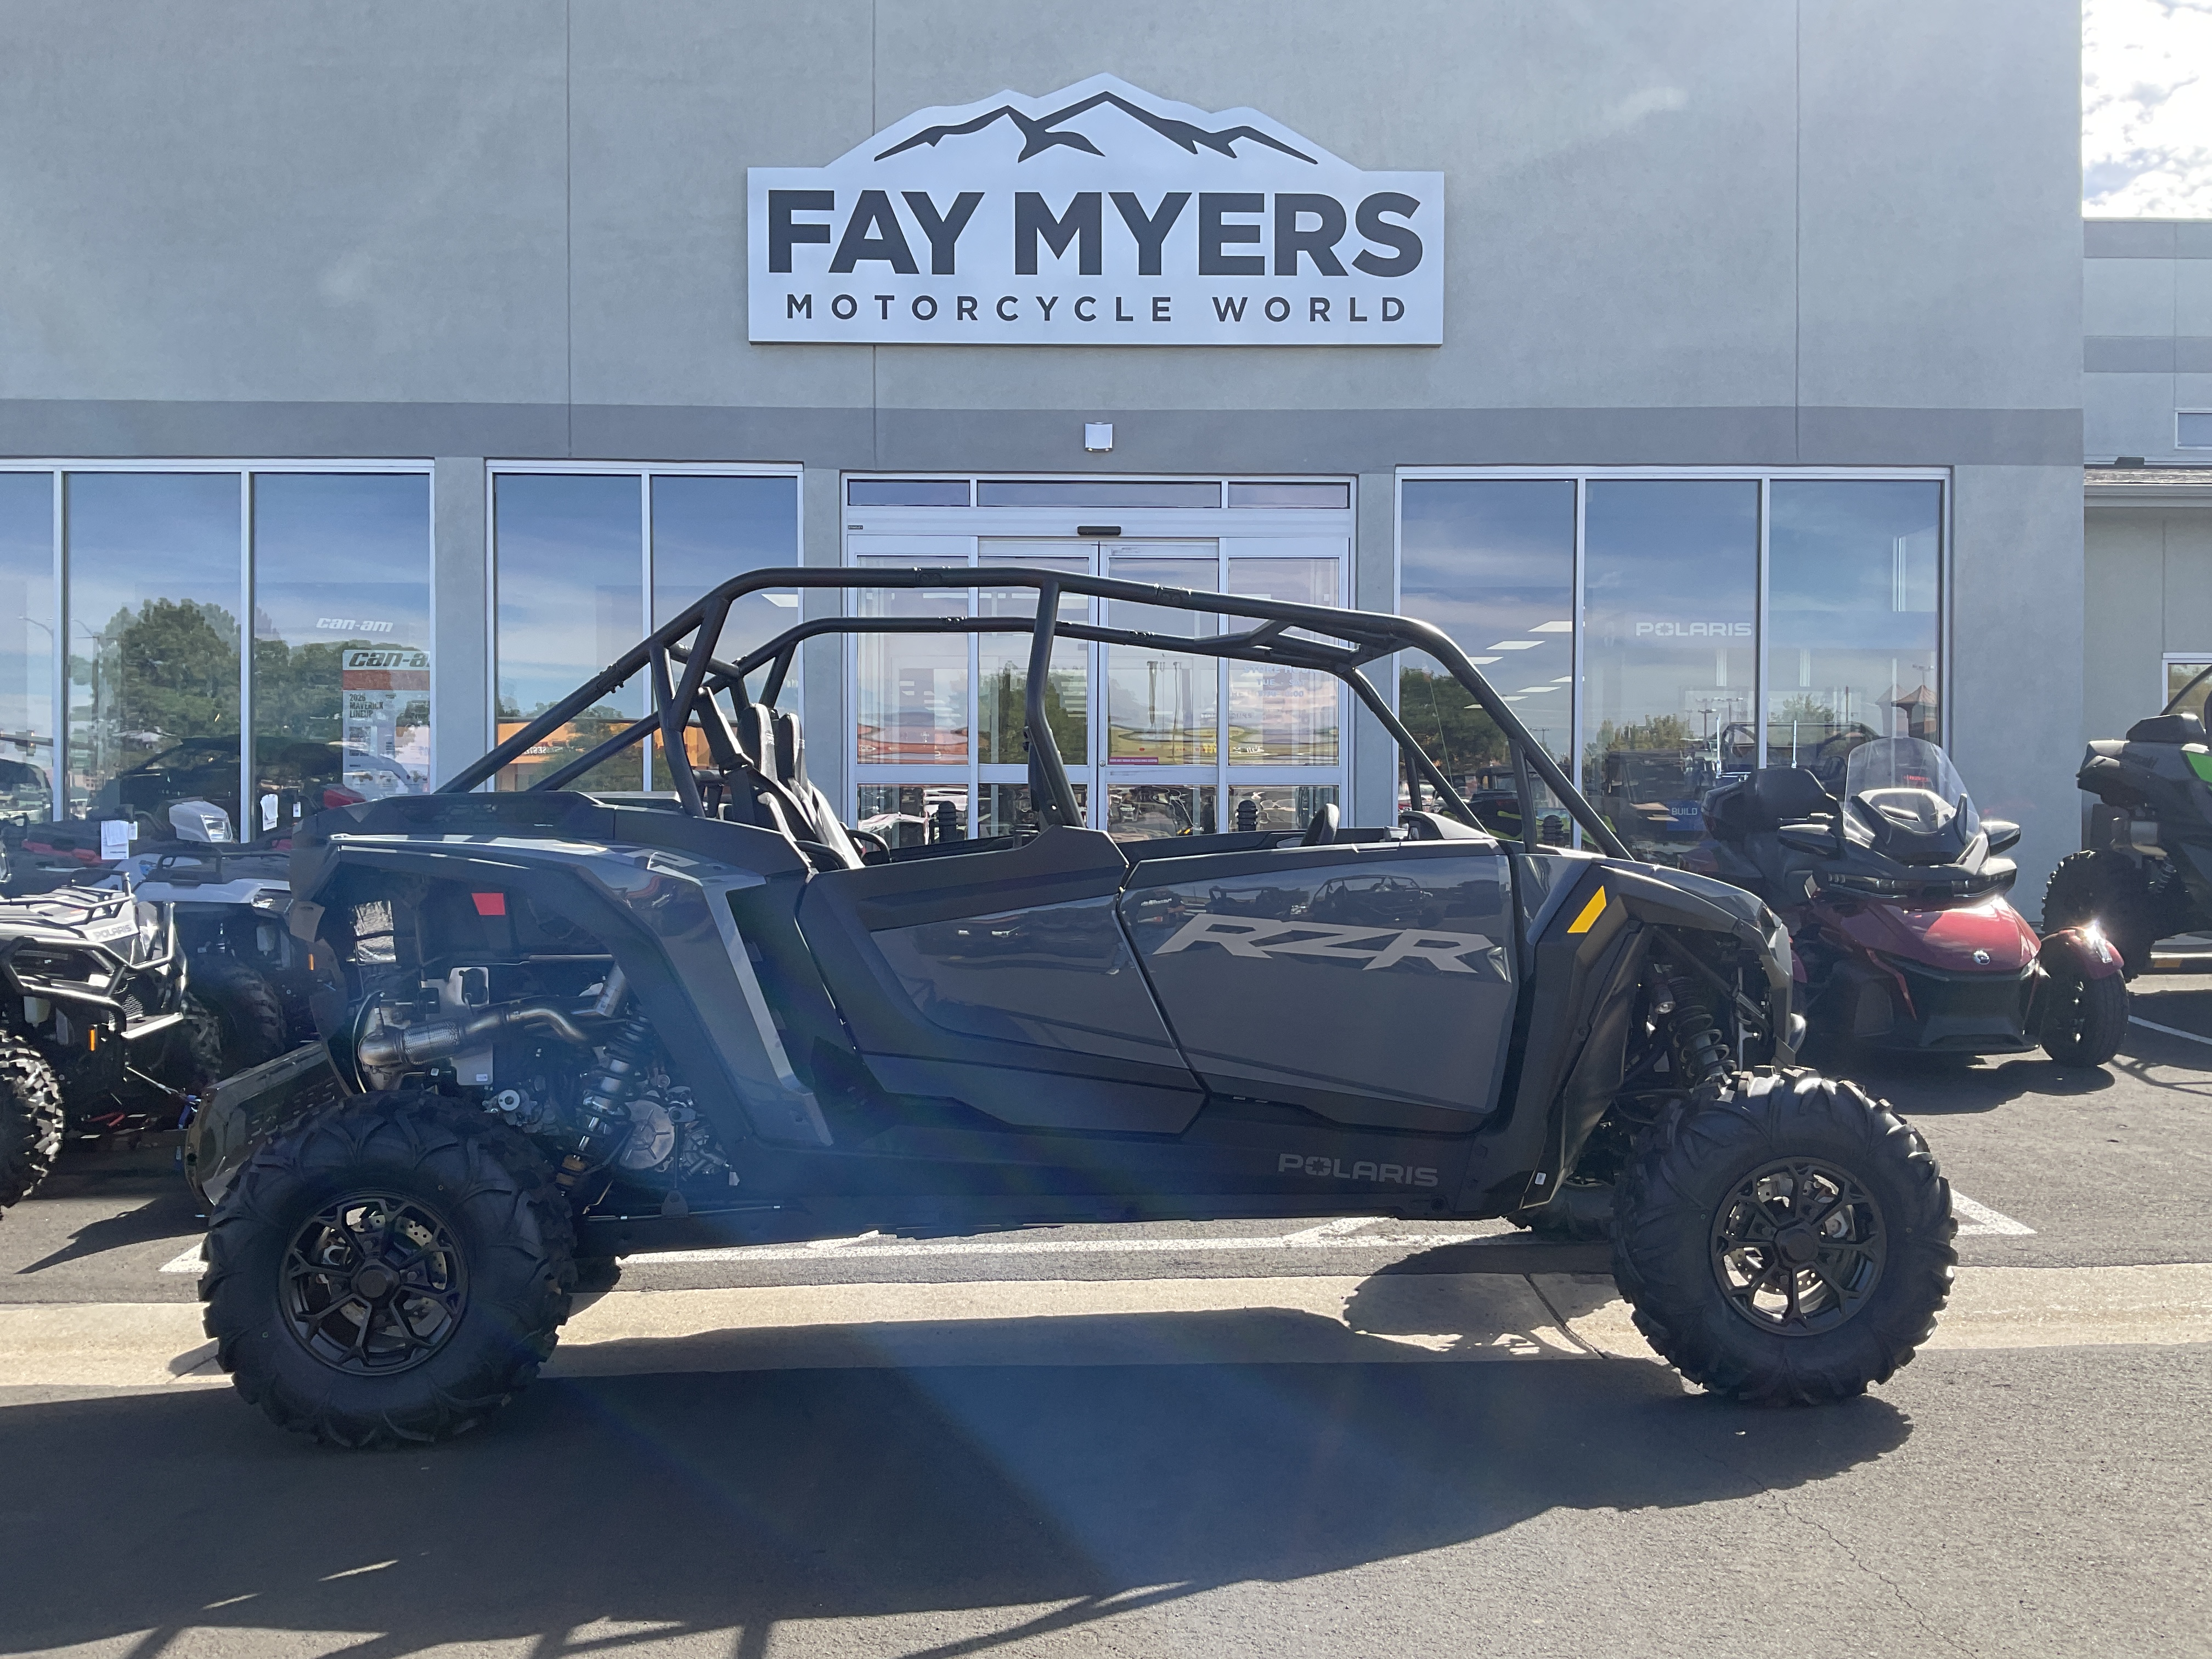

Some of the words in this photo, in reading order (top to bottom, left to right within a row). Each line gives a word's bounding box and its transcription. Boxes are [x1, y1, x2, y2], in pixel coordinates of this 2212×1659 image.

[769, 190, 985, 275] FAY
[1015, 191, 1423, 277] MYERS
[787, 294, 1171, 323] MOTORCYCLE
[1212, 297, 1405, 322] WORLD
[316, 618, 393, 632] can-am
[1636, 622, 1752, 636] POLARIS
[349, 652, 430, 667] can-a
[1672, 807, 1697, 815] BUILD
[92, 924, 132, 939] POLARIS
[1152, 913, 1495, 973] RZR
[1278, 1153, 1438, 1187] POLARIS
